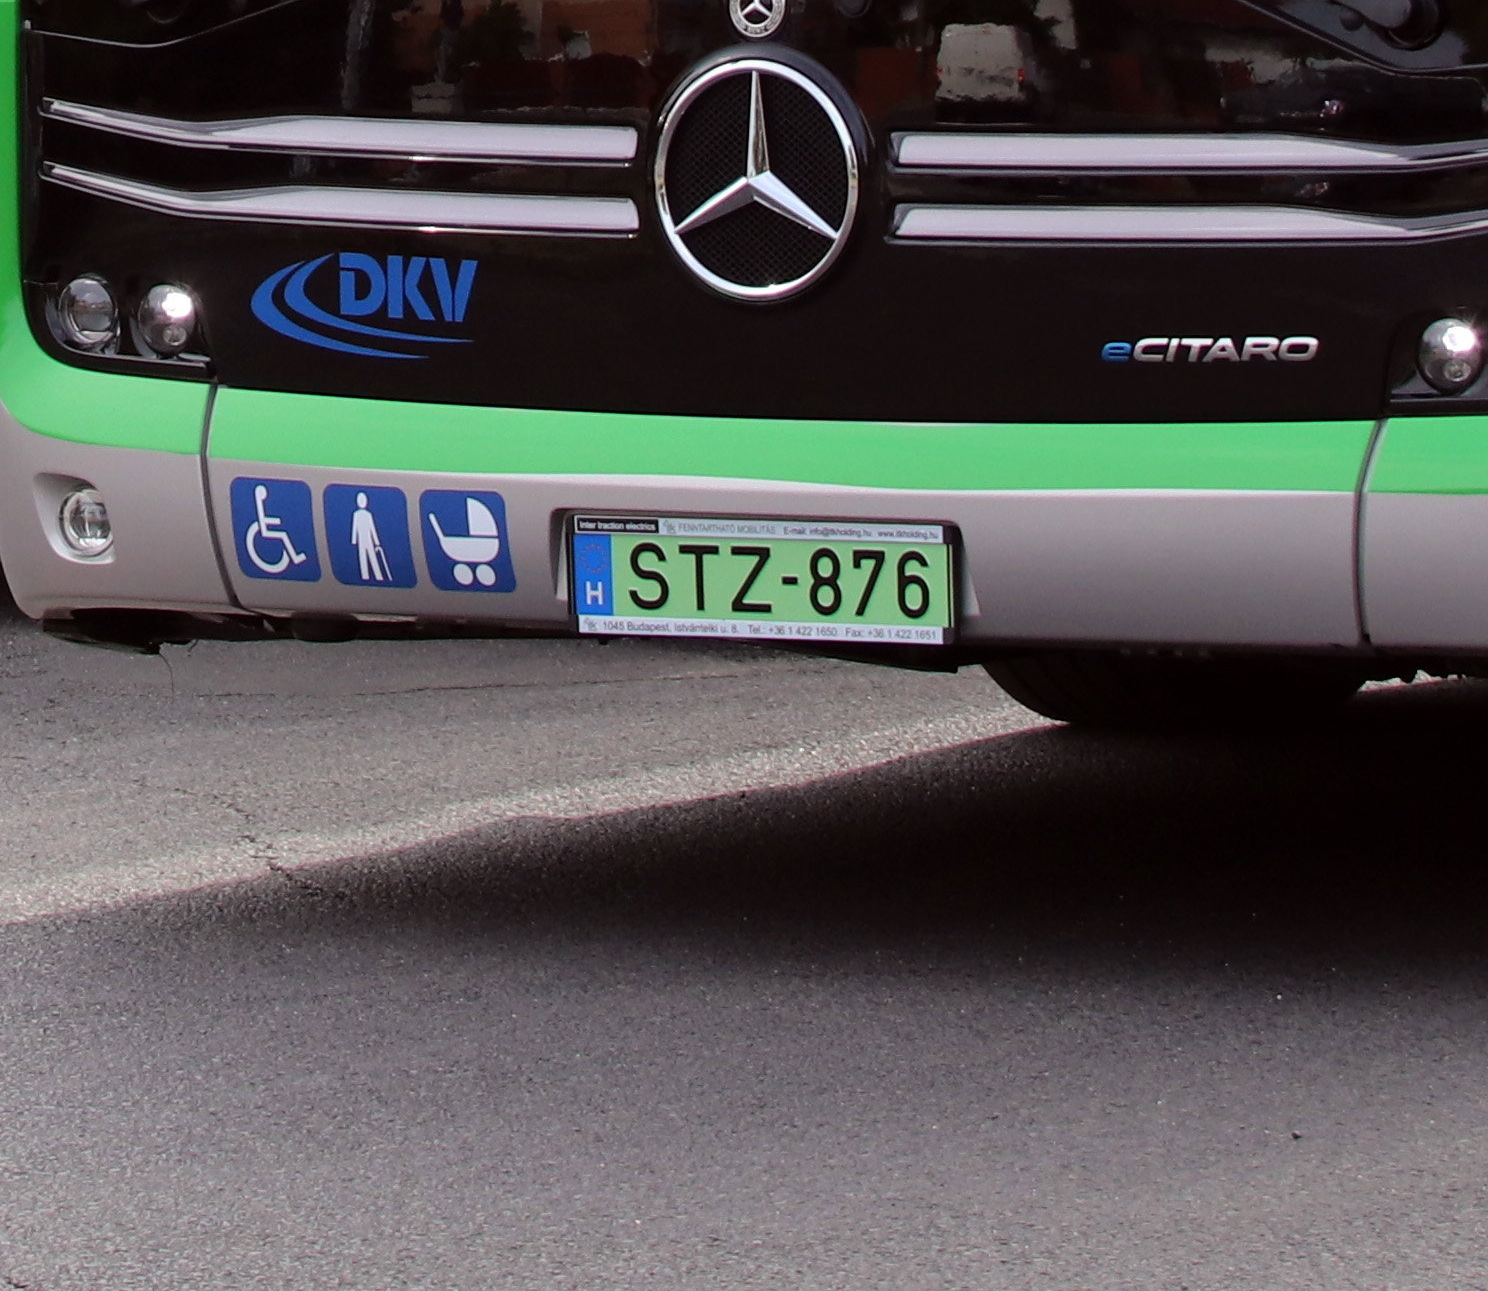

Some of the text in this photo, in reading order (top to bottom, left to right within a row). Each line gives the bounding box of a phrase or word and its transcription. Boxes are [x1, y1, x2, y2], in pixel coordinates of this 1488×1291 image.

[338, 251, 479, 323] DKV
[1101, 336, 1320, 363] eCITARO
[578, 520, 597, 530] Inter
[597, 520, 624, 530] traction
[625, 521, 656, 531] electrics
[585, 580, 604, 606] H
[628, 541, 931, 619] STZ-876
[602, 620, 625, 631] 1045
[795, 626, 813, 636] 422
[815, 627, 838, 637] 1650
[895, 629, 912, 639] 422
[915, 630, 936, 640] 1651
